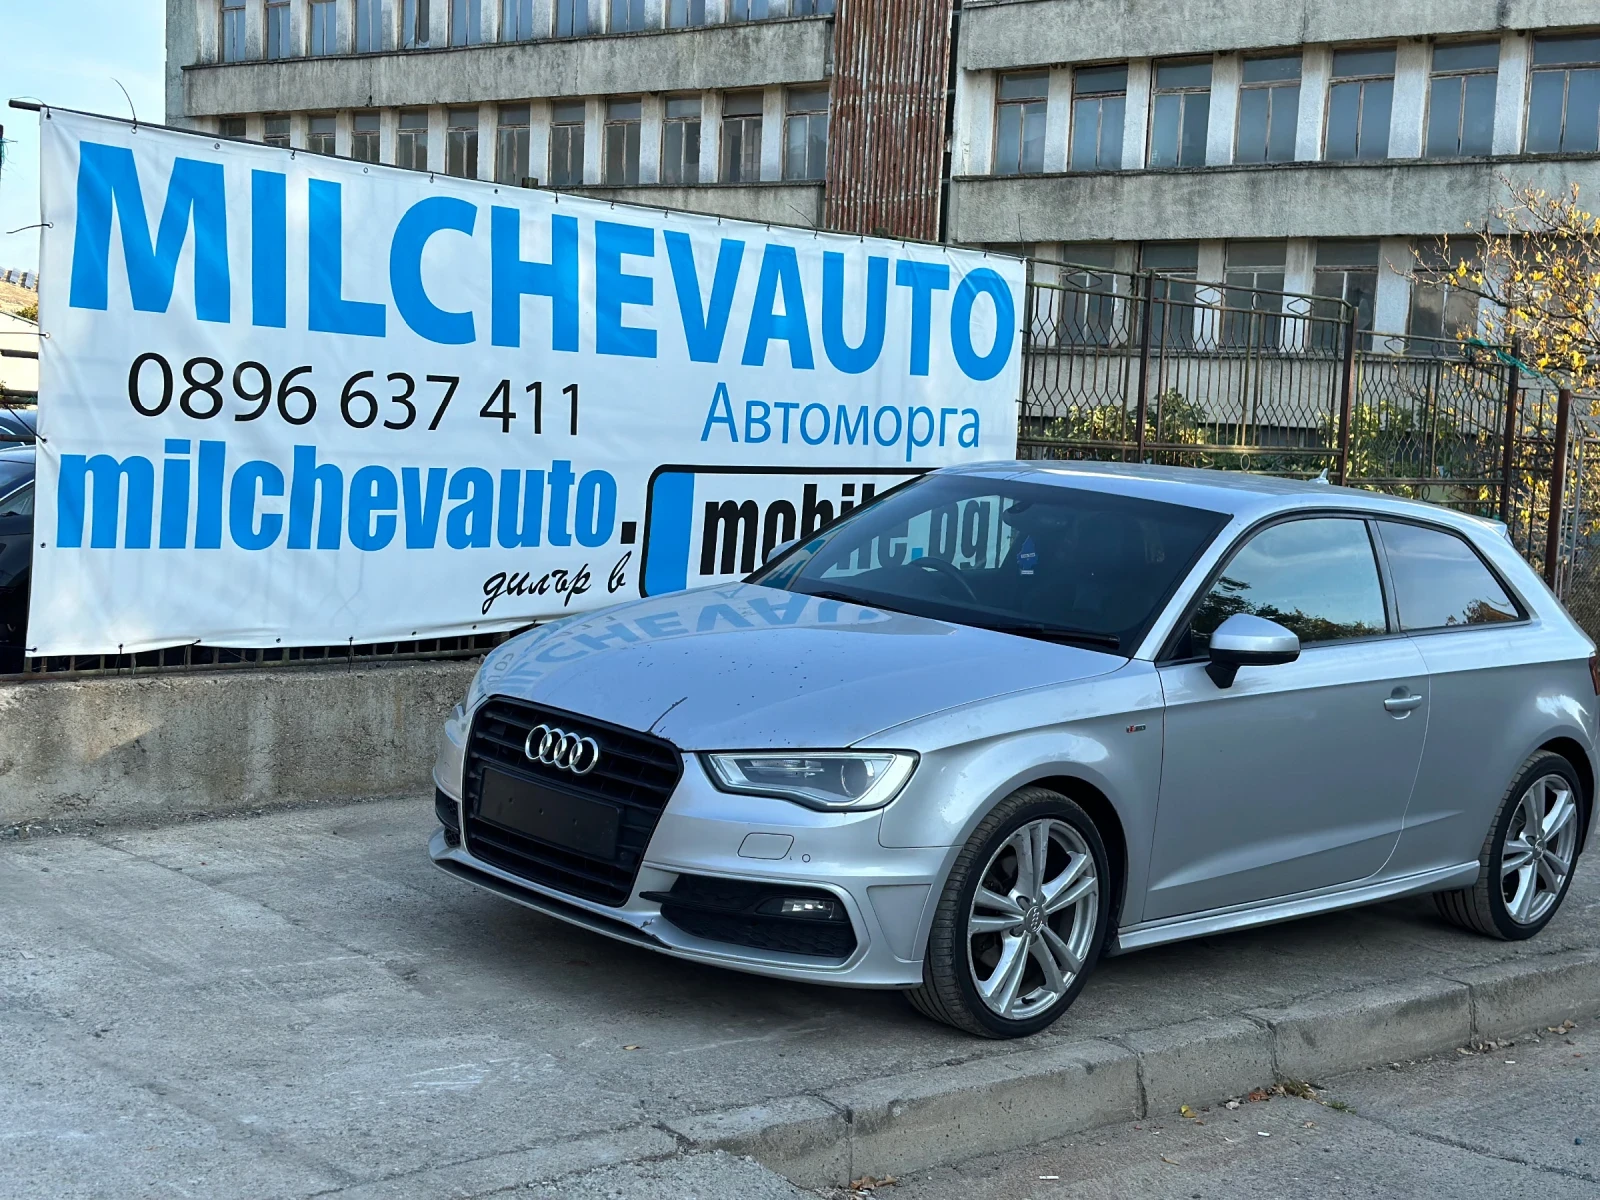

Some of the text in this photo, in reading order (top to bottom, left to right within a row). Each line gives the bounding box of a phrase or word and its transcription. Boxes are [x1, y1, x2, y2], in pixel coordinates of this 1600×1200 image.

[69, 140, 1017, 383] MILCHEVAUTO
[128, 352, 579, 436] 0896 637 411
[700, 381, 981, 462] Автоморга
